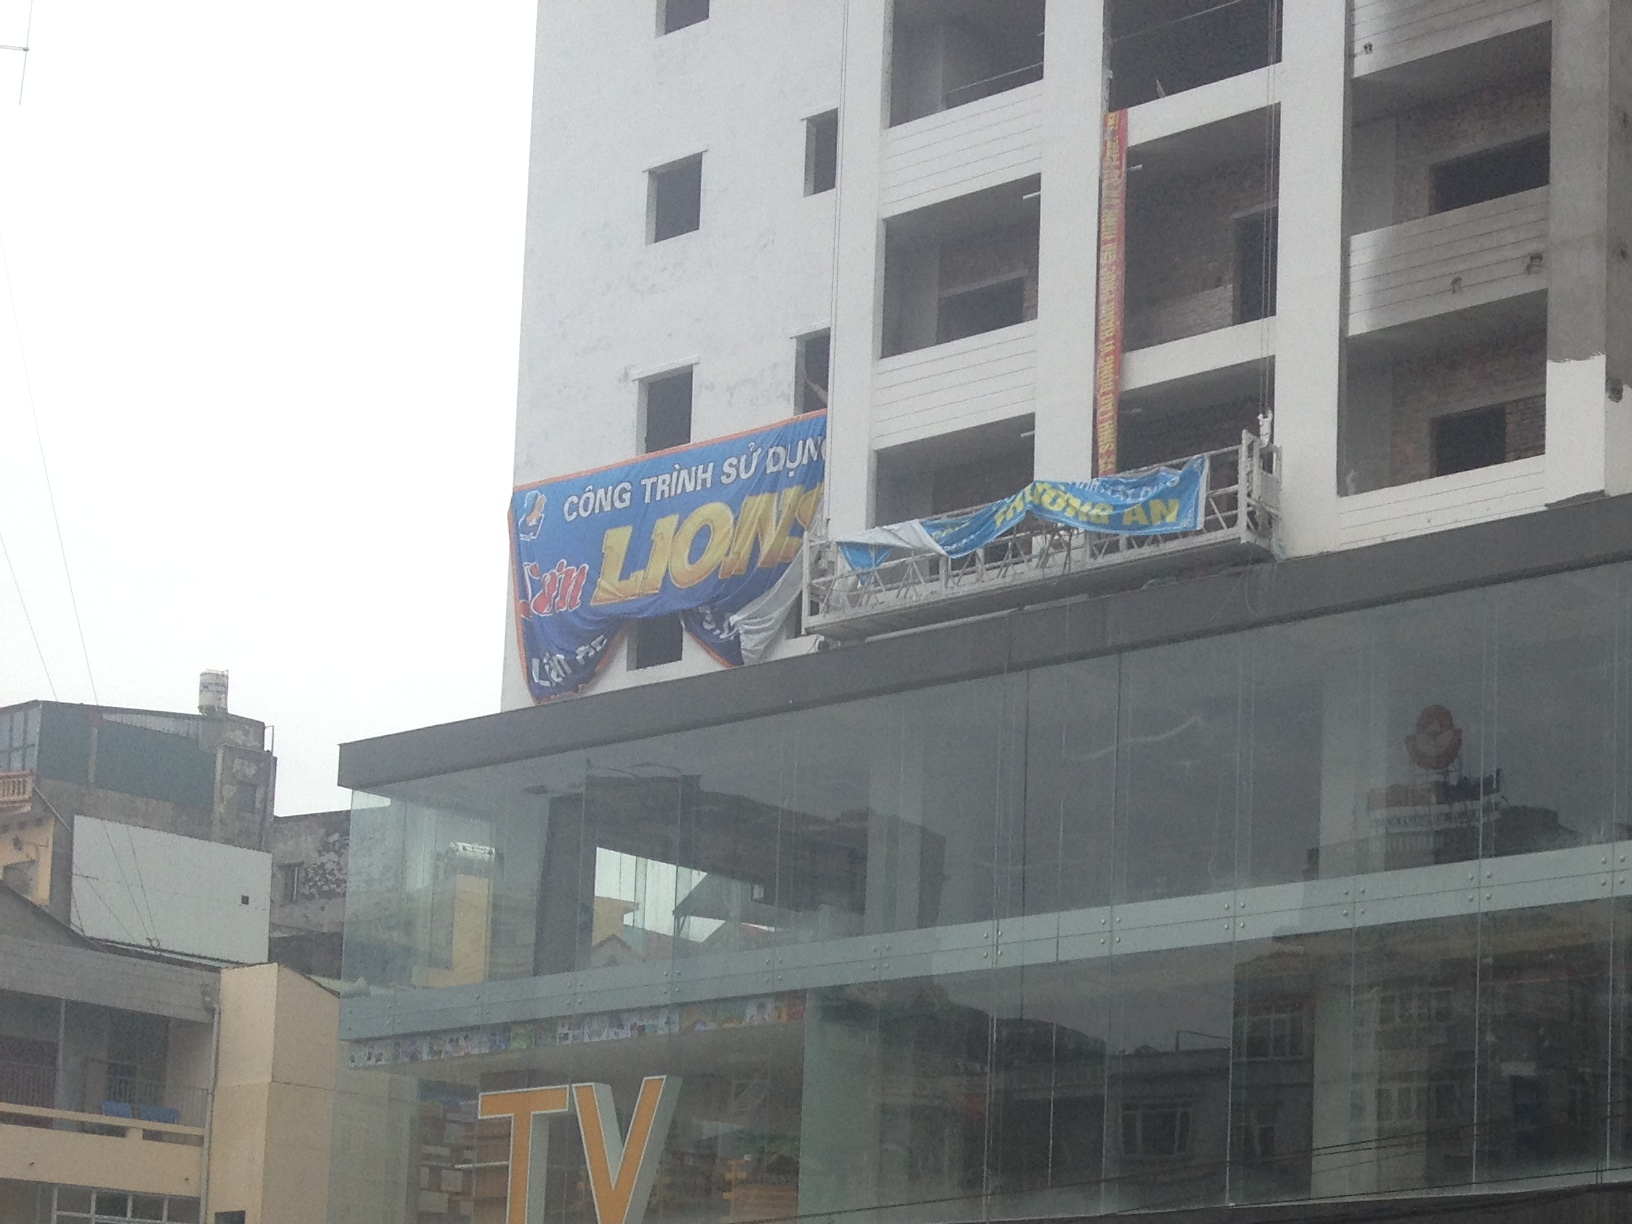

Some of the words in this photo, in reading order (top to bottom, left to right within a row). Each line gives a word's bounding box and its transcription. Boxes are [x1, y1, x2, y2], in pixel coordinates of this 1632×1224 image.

[563, 485, 632, 522] CÔNG
[641, 463, 714, 503] TRÌNH
[721, 442, 763, 485] SỬ
[766, 436, 827, 478] DỤN
[1122, 498, 1180, 527] AN
